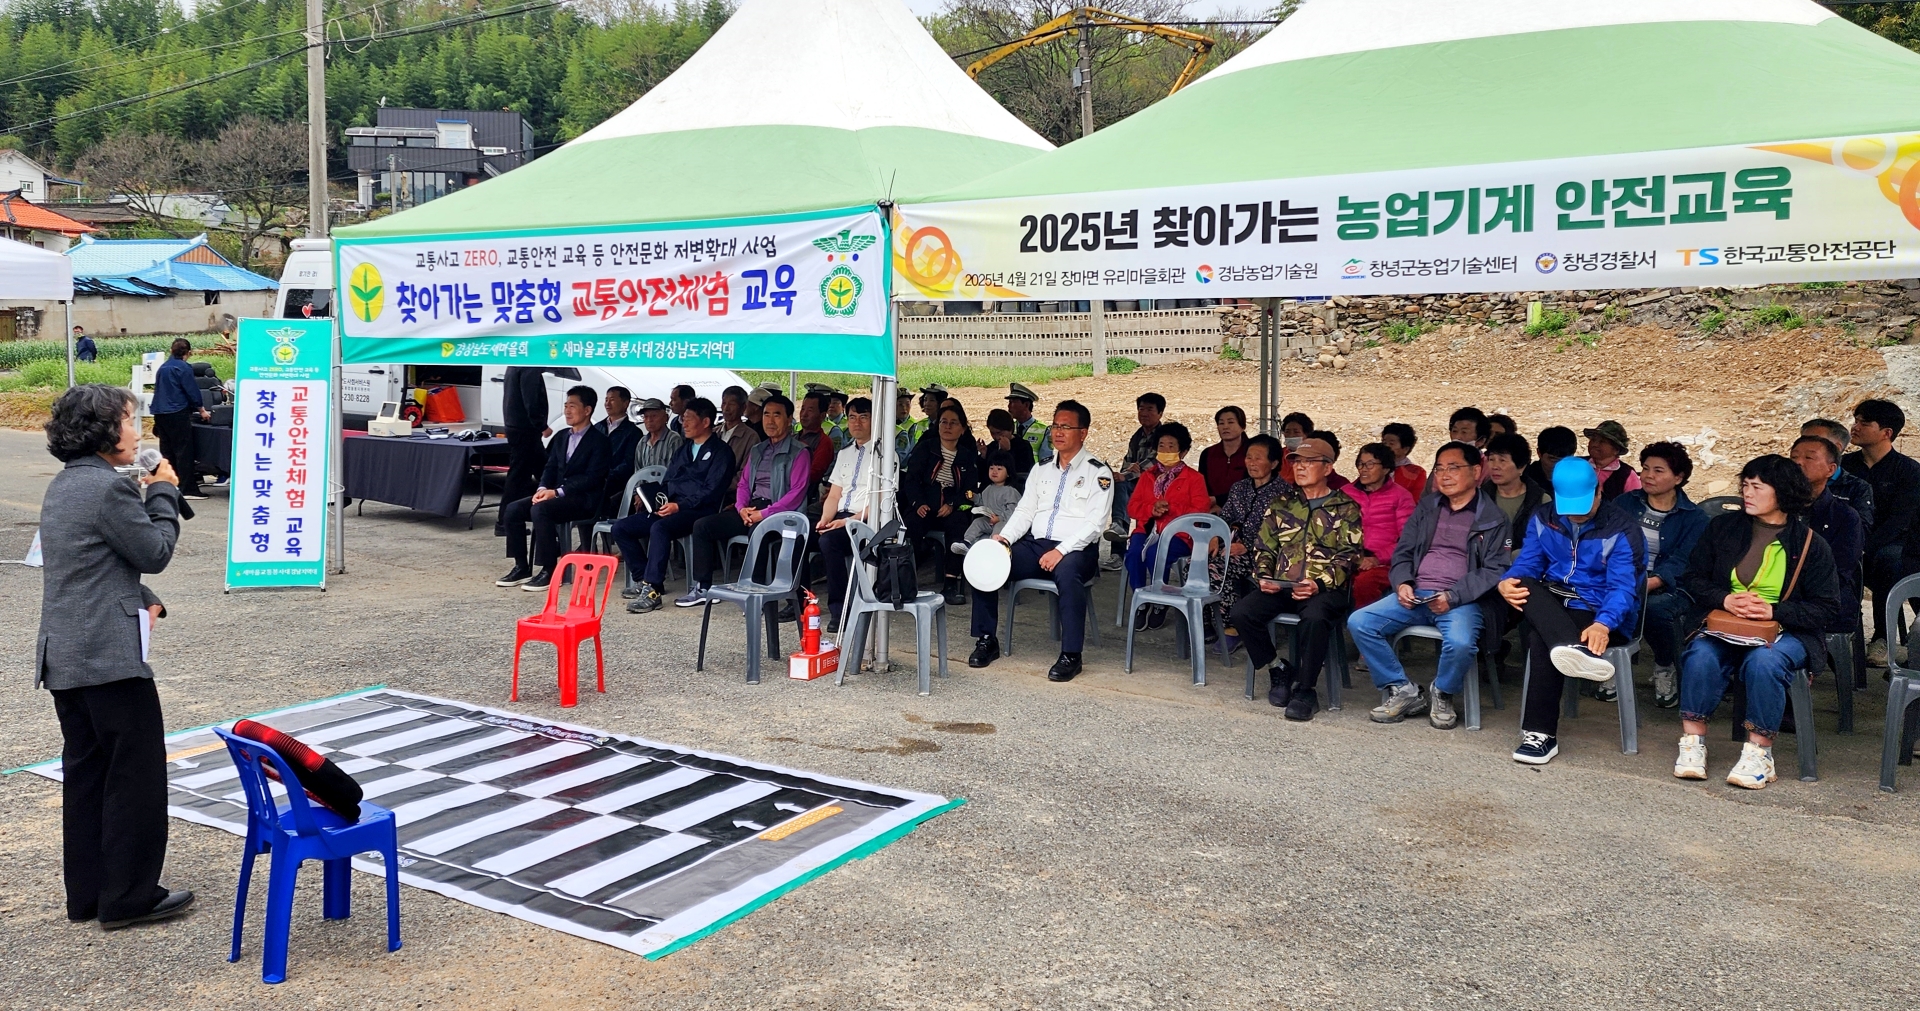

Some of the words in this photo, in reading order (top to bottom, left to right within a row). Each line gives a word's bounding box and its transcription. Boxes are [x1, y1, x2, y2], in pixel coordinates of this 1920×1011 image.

[1019, 209, 1139, 253] 2025년
[1152, 199, 1320, 249] 찾아가는
[1336, 184, 1535, 241] 농업기계
[1555, 166, 1793, 231] 안전교육
[415, 250, 460, 272] 교통사고
[464, 249, 502, 267] ZERO,
[507, 245, 557, 269] 교통안전
[562, 244, 587, 267] 교육
[592, 244, 605, 267] 등
[610, 241, 669, 266] 안전문화
[673, 237, 737, 262] 저변확대
[741, 235, 777, 258] 사업
[1369, 255, 1518, 278] 창녕군농업기술센터
[1562, 249, 1657, 272] 창녕경찰서
[1677, 248, 1720, 266] TS
[1723, 239, 1897, 265] 한국교통안전공단
[964, 272, 1004, 287] 2025년
[1007, 271, 1027, 287] 4월
[1029, 271, 1057, 287] 21일
[1060, 270, 1099, 287] 장마면
[1102, 267, 1187, 286] 유리마을회관
[1218, 262, 1318, 282] 경남농업기술원
[395, 281, 484, 324] 찾아가는
[490, 277, 563, 325] 맞춤형
[740, 264, 798, 316] 교육
[285, 386, 309, 509] 교통안전체험
[284, 516, 303, 557] 교육
